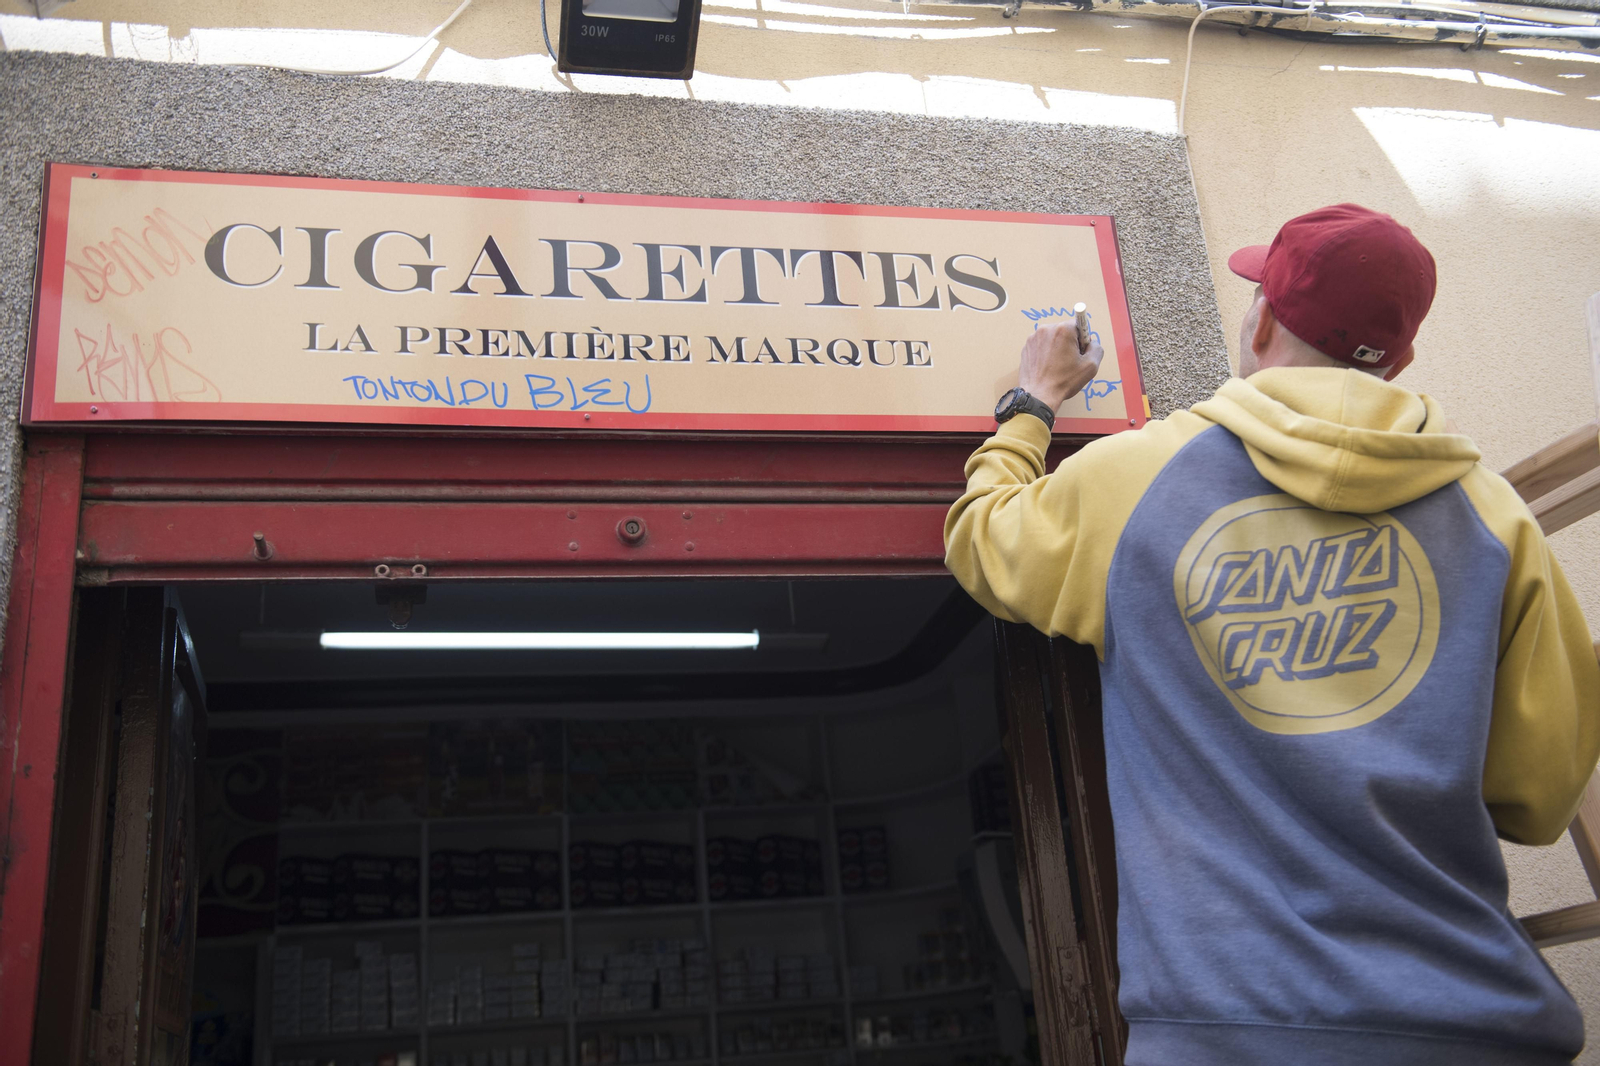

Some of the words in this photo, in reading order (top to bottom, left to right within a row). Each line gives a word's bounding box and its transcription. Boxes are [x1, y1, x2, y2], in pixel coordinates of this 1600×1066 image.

[581, 25, 609, 37] 30W
[655, 34, 676, 43] IP65
[204, 223, 1007, 312] CIGARETTES
[302, 322, 378, 354] LA
[394, 325, 692, 362] PREMIÈRE
[704, 334, 934, 367] MARQUE
[525, 374, 651, 414] BLEU
[1185, 525, 1399, 625] SANTA
[1219, 598, 1397, 690] CRUZ
